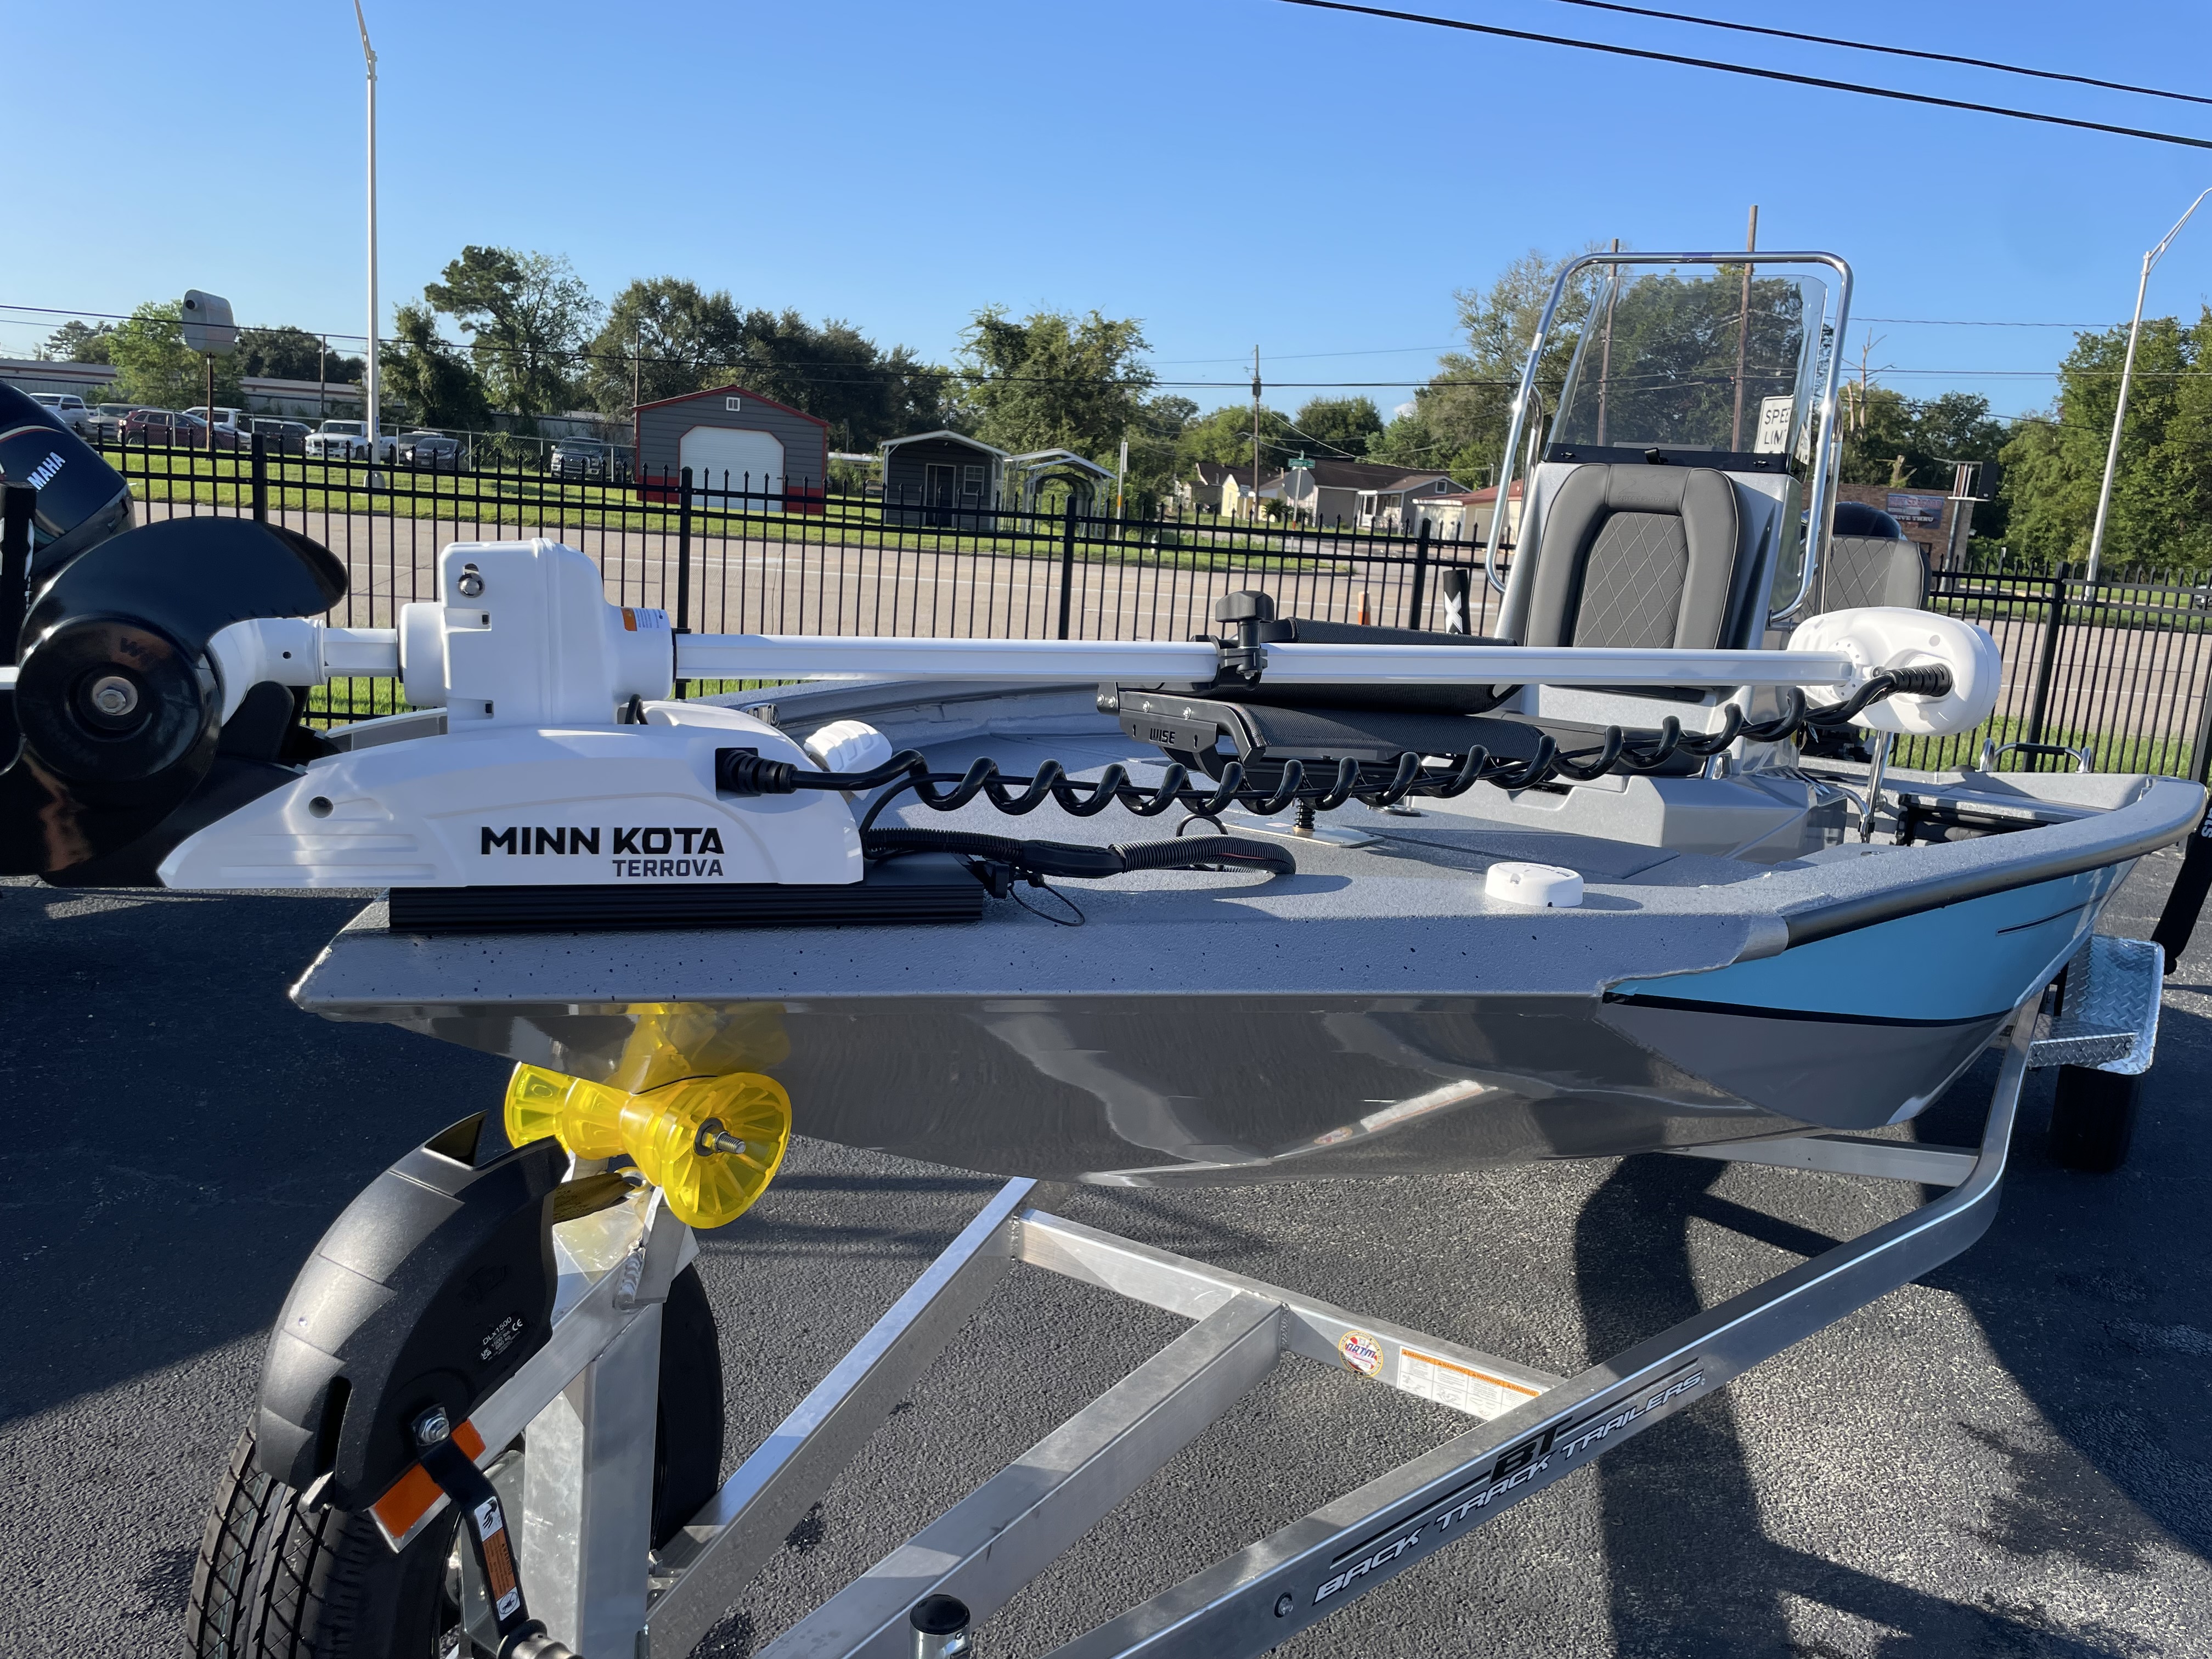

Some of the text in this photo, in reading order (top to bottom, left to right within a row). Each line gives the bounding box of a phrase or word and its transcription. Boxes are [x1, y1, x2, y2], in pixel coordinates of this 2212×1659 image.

[1764, 407, 1791, 425] SPEE
[27, 452, 66, 490] MAHA
[1149, 727, 1176, 744] WISE
[481, 826, 725, 855] MINN KOTA
[612, 859, 724, 877] TERROVA
[1408, 1352, 1431, 1362] WARNING
[1442, 1362, 1466, 1373] WARNING
[1477, 1374, 1501, 1385] WARNING
[1511, 1385, 1536, 1396] WARNING
[1313, 1369, 1703, 1605] BACK TRACK TRAILERS
